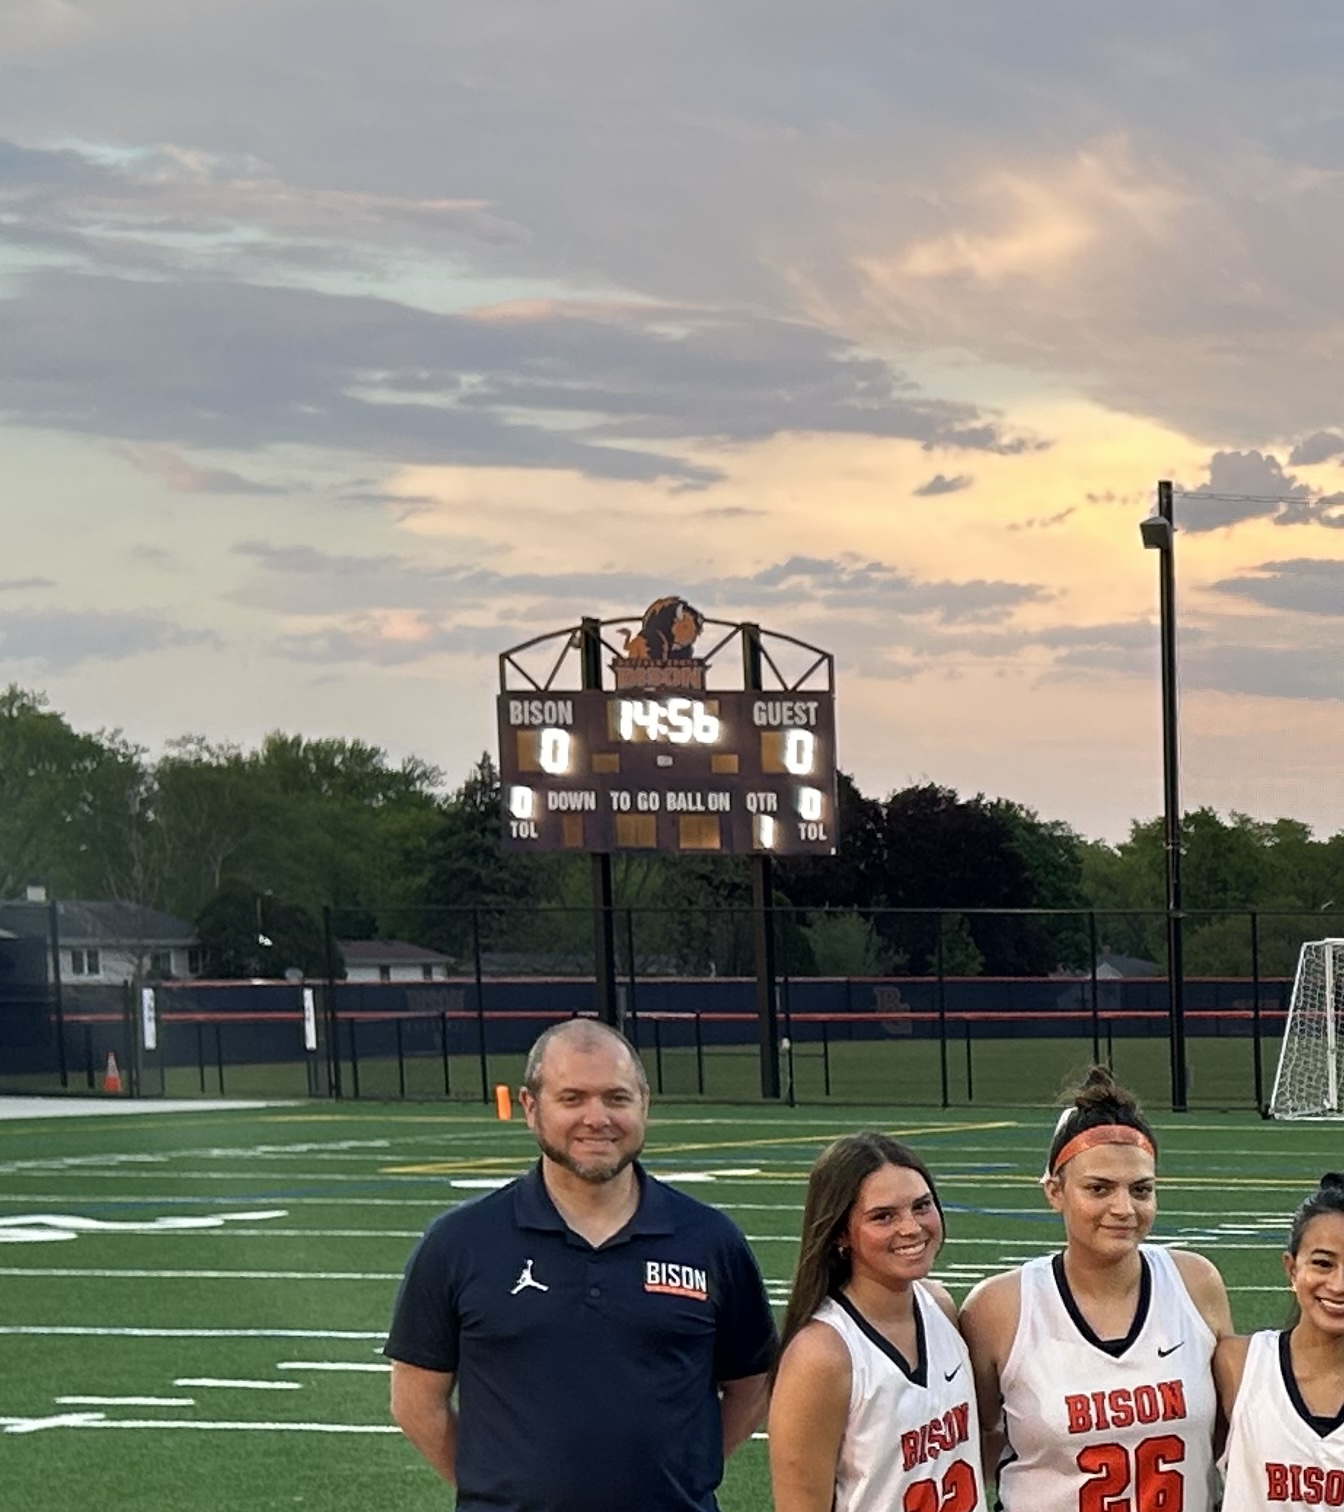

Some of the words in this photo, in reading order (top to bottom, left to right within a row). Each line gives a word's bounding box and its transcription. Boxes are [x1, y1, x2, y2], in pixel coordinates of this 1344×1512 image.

[509, 700, 573, 725] BISON
[620, 698, 719, 743] 14:56
[753, 701, 818, 725] GUEST
[539, 727, 571, 774] 0
[785, 728, 814, 775] 0
[510, 786, 533, 819] 0
[548, 791, 597, 811] DOWN
[610, 791, 631, 811] TO
[637, 791, 660, 811] GO
[666, 792, 705, 812] BALL
[708, 792, 731, 811] ON
[746, 793, 777, 813] QTR
[799, 787, 821, 820] 0
[510, 821, 539, 838] TOL
[760, 814, 774, 849] 1
[798, 823, 827, 841] TOL
[646, 1261, 708, 1293] BISON
[1065, 1380, 1186, 1434] BISON
[901, 1402, 969, 1472] BISON
